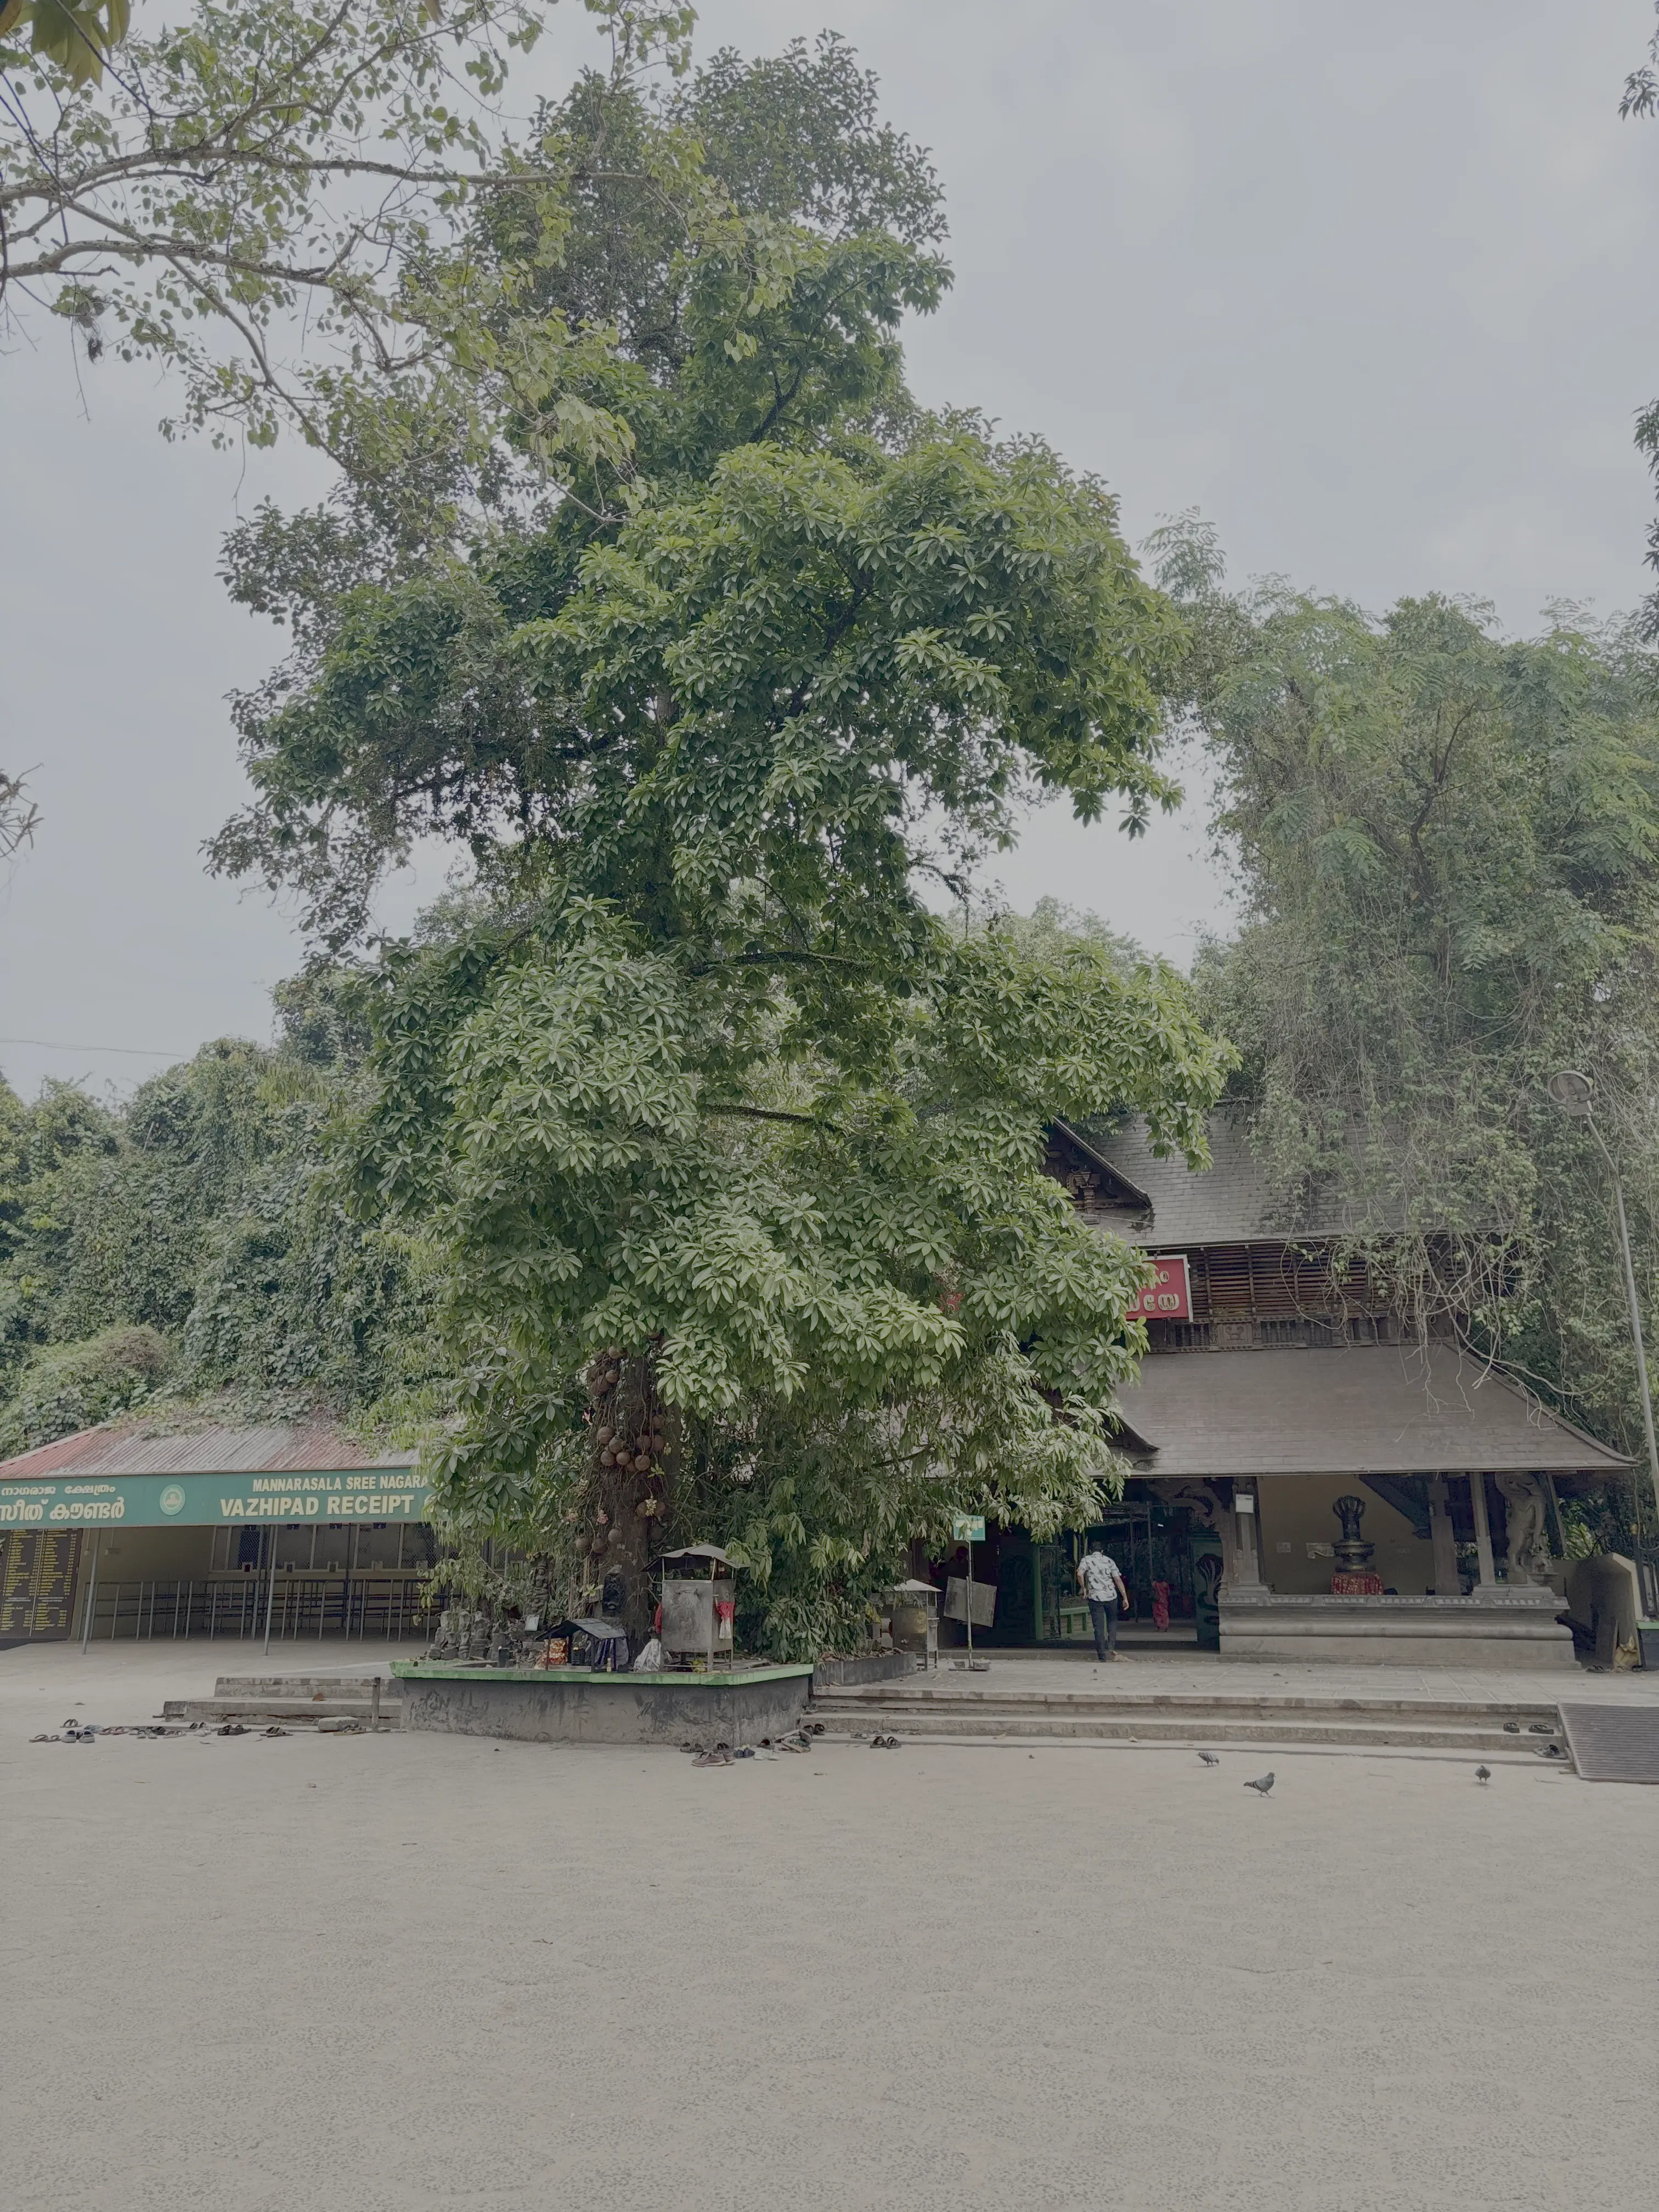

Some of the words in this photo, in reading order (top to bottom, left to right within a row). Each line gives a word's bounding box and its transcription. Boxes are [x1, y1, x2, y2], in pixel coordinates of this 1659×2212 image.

[252, 1477, 342, 1492] MANNARASALA
[346, 1475, 376, 1490] SREE
[380, 1475, 428, 1489] NAGARA
[0, 1499, 49, 1521] സീത്
[220, 1497, 319, 1517] VAZHIPAD
[327, 1494, 415, 1515] RECEIPT
